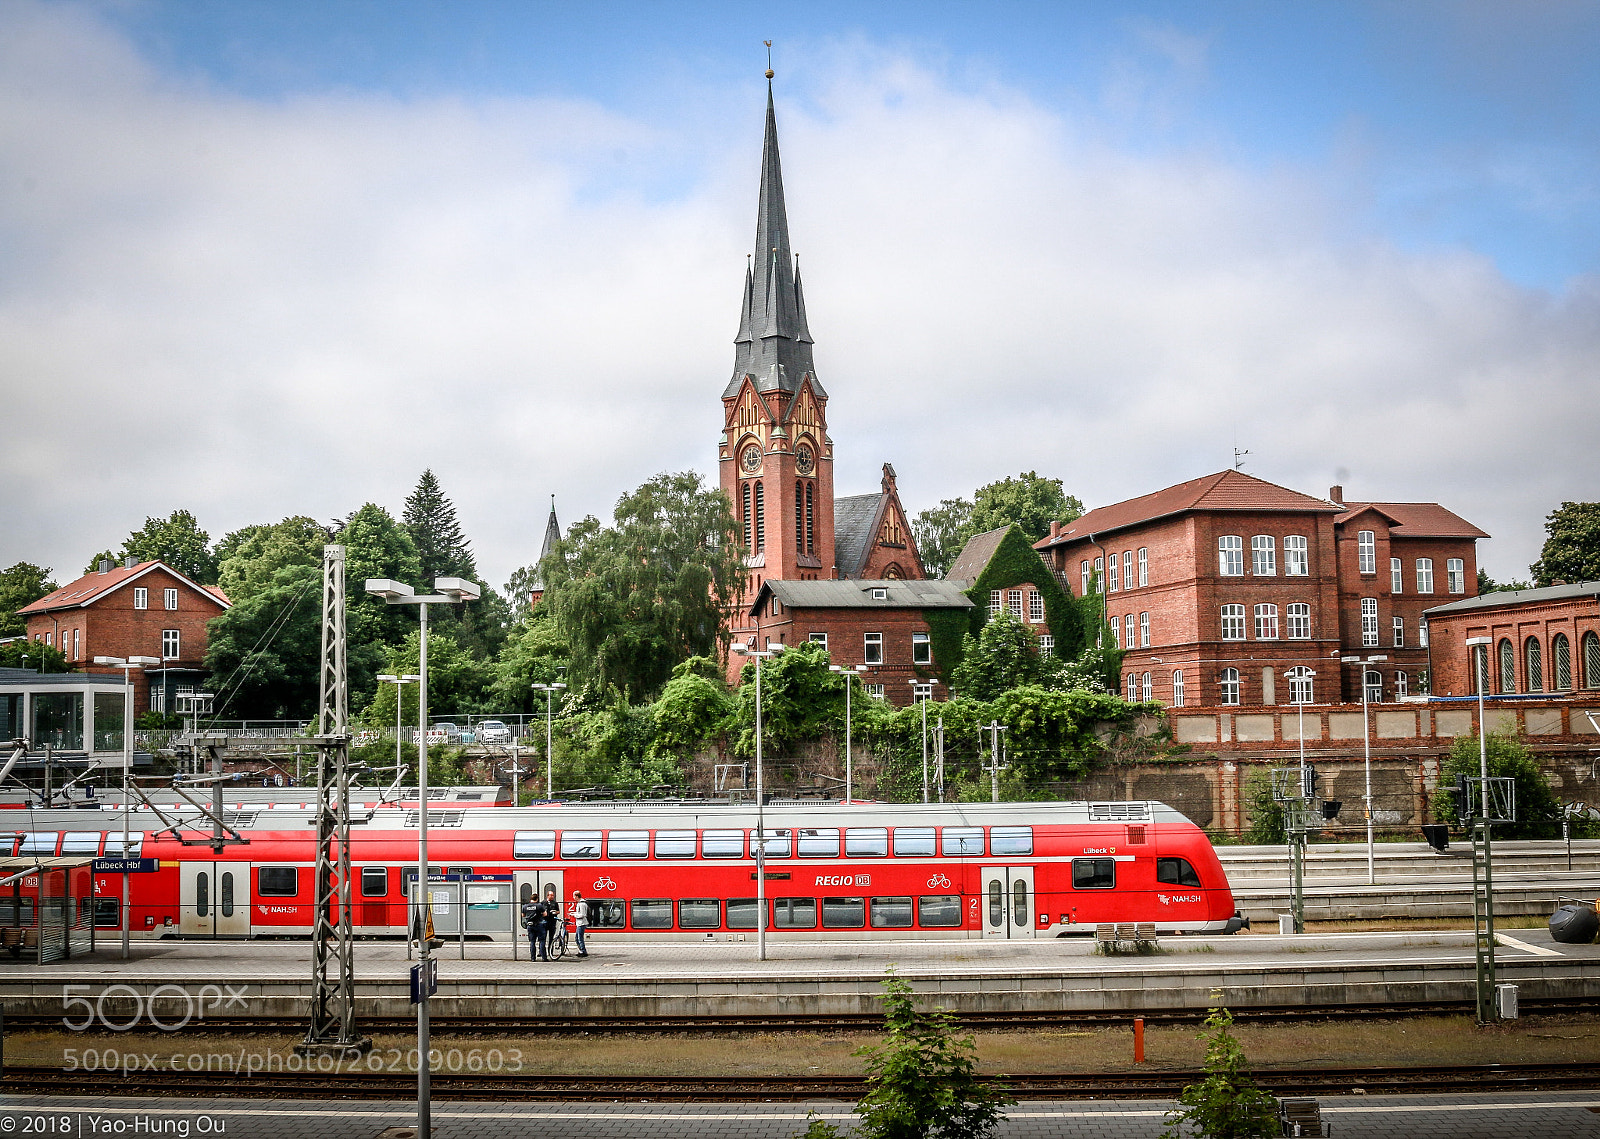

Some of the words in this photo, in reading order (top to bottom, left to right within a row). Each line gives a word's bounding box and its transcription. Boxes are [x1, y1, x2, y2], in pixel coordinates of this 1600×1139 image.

[95, 861, 124, 870] Lübeck
[126, 861, 141, 869] Hbf
[815, 875, 853, 886] REGIO
[855, 874, 870, 886] DB
[568, 902, 575, 911] 2
[970, 898, 978, 909] 2
